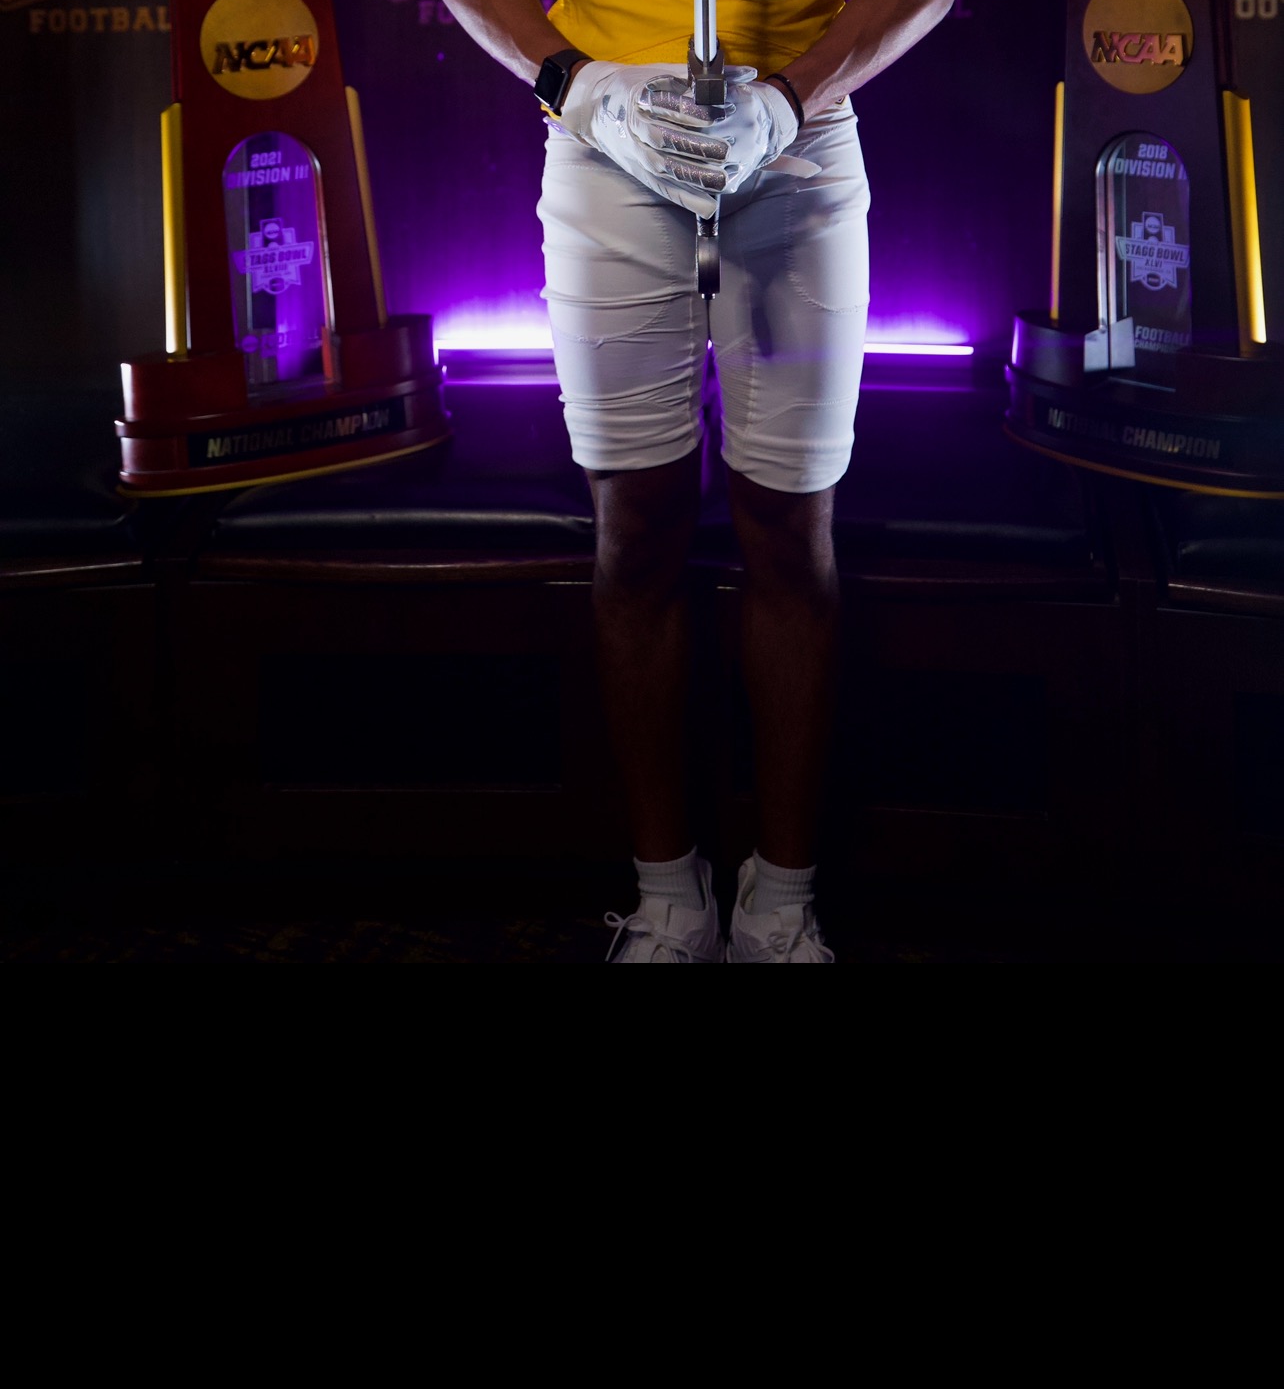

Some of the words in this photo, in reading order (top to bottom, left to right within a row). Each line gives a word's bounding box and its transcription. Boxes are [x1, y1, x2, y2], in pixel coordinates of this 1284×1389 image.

[212, 35, 316, 74] NCAA
[1091, 31, 1188, 66] NCAA
[250, 151, 282, 168] 2021
[1138, 143, 1168, 160] 2018
[294, 164, 310, 180] III
[1115, 158, 1176, 180] DIVISION
[1156, 248, 1184, 262] BOWL
[207, 427, 294, 459] NATIONAL
[300, 408, 391, 443] CHAMPION
[1122, 425, 1220, 460] CHAMPION
